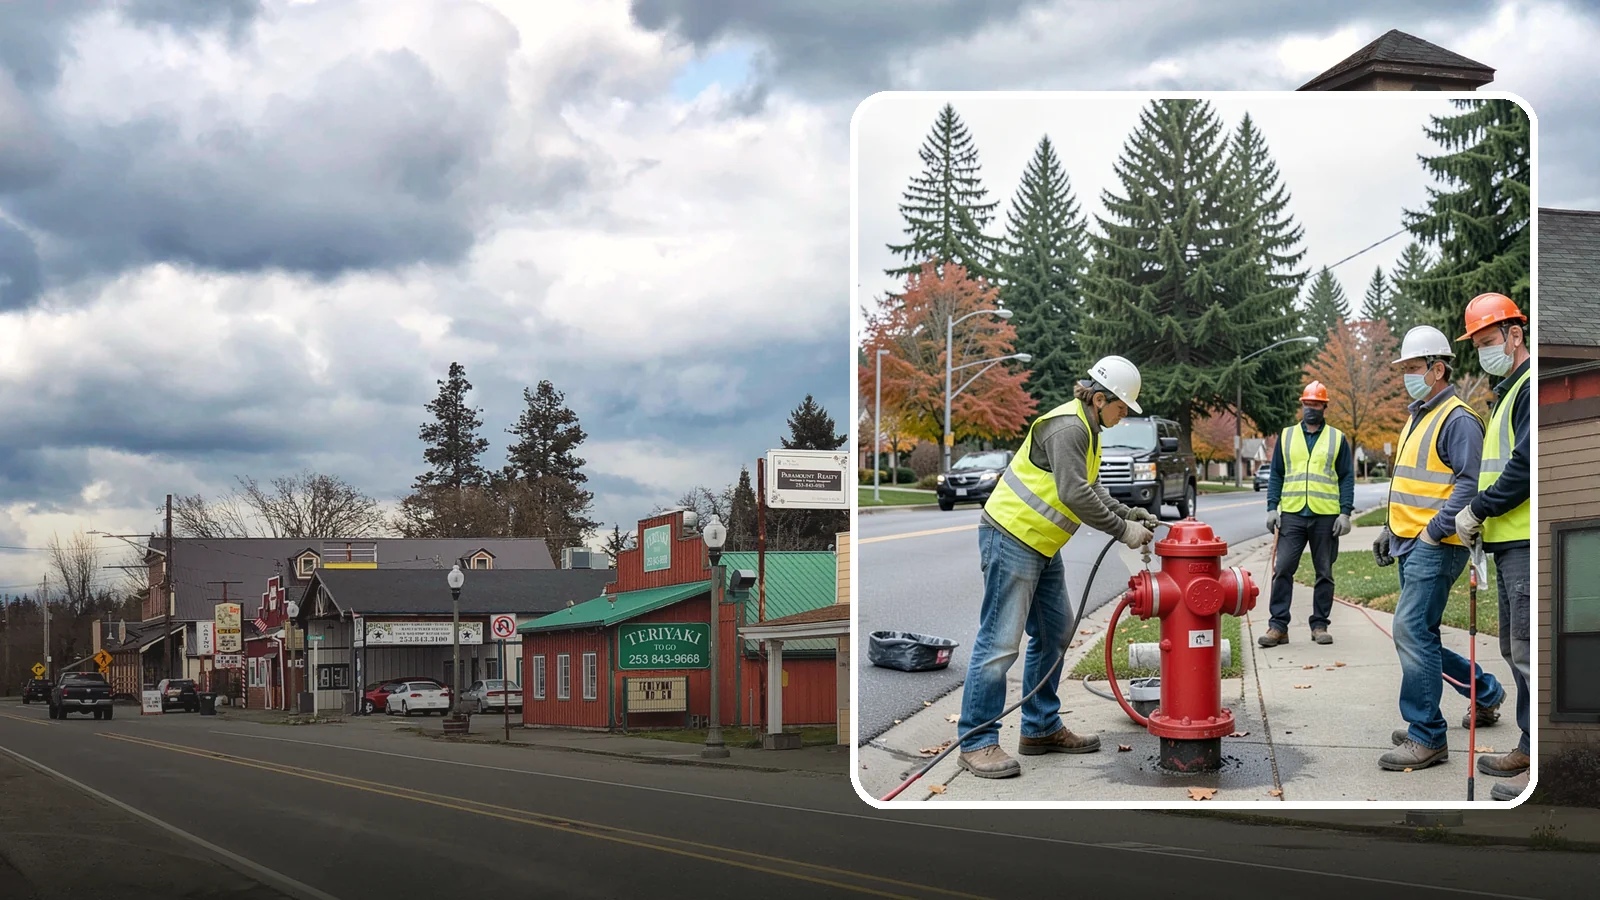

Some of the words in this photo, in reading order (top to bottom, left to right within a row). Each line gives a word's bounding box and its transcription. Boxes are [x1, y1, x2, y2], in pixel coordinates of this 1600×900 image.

[625, 627, 702, 646] TERIYAKI
[629, 654, 649, 665] 253
[651, 653, 700, 664] 843-9668
[639, 681, 672, 691] TERIYAKI
